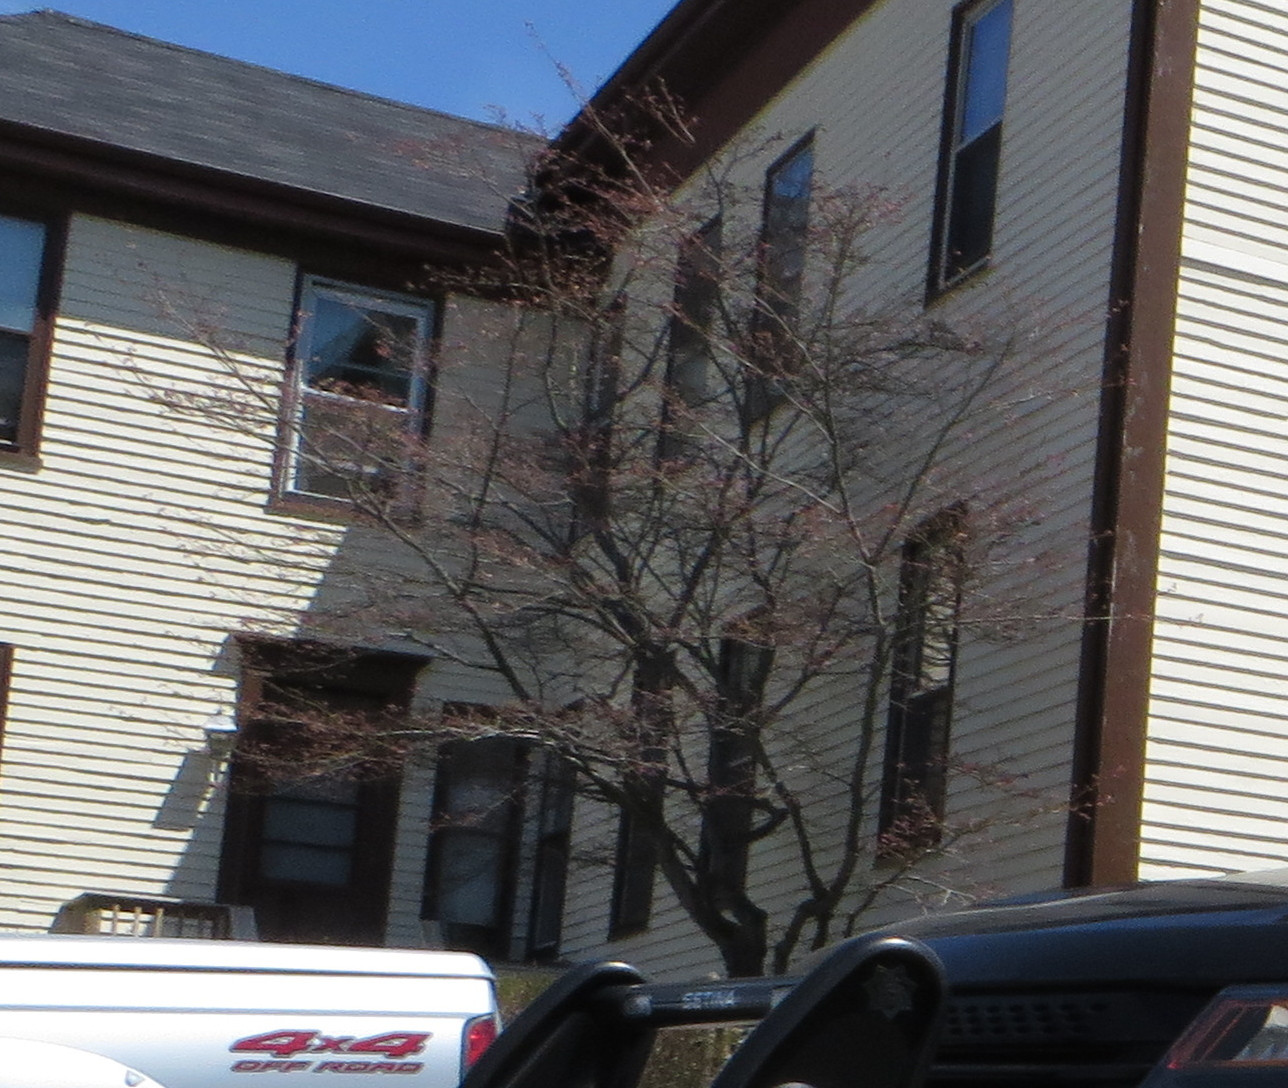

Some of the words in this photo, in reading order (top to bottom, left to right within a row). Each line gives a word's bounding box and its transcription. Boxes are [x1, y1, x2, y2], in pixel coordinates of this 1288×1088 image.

[228, 1029, 433, 1059] 4x4
[231, 1060, 312, 1073] OFF
[312, 1061, 427, 1075] ROAD
